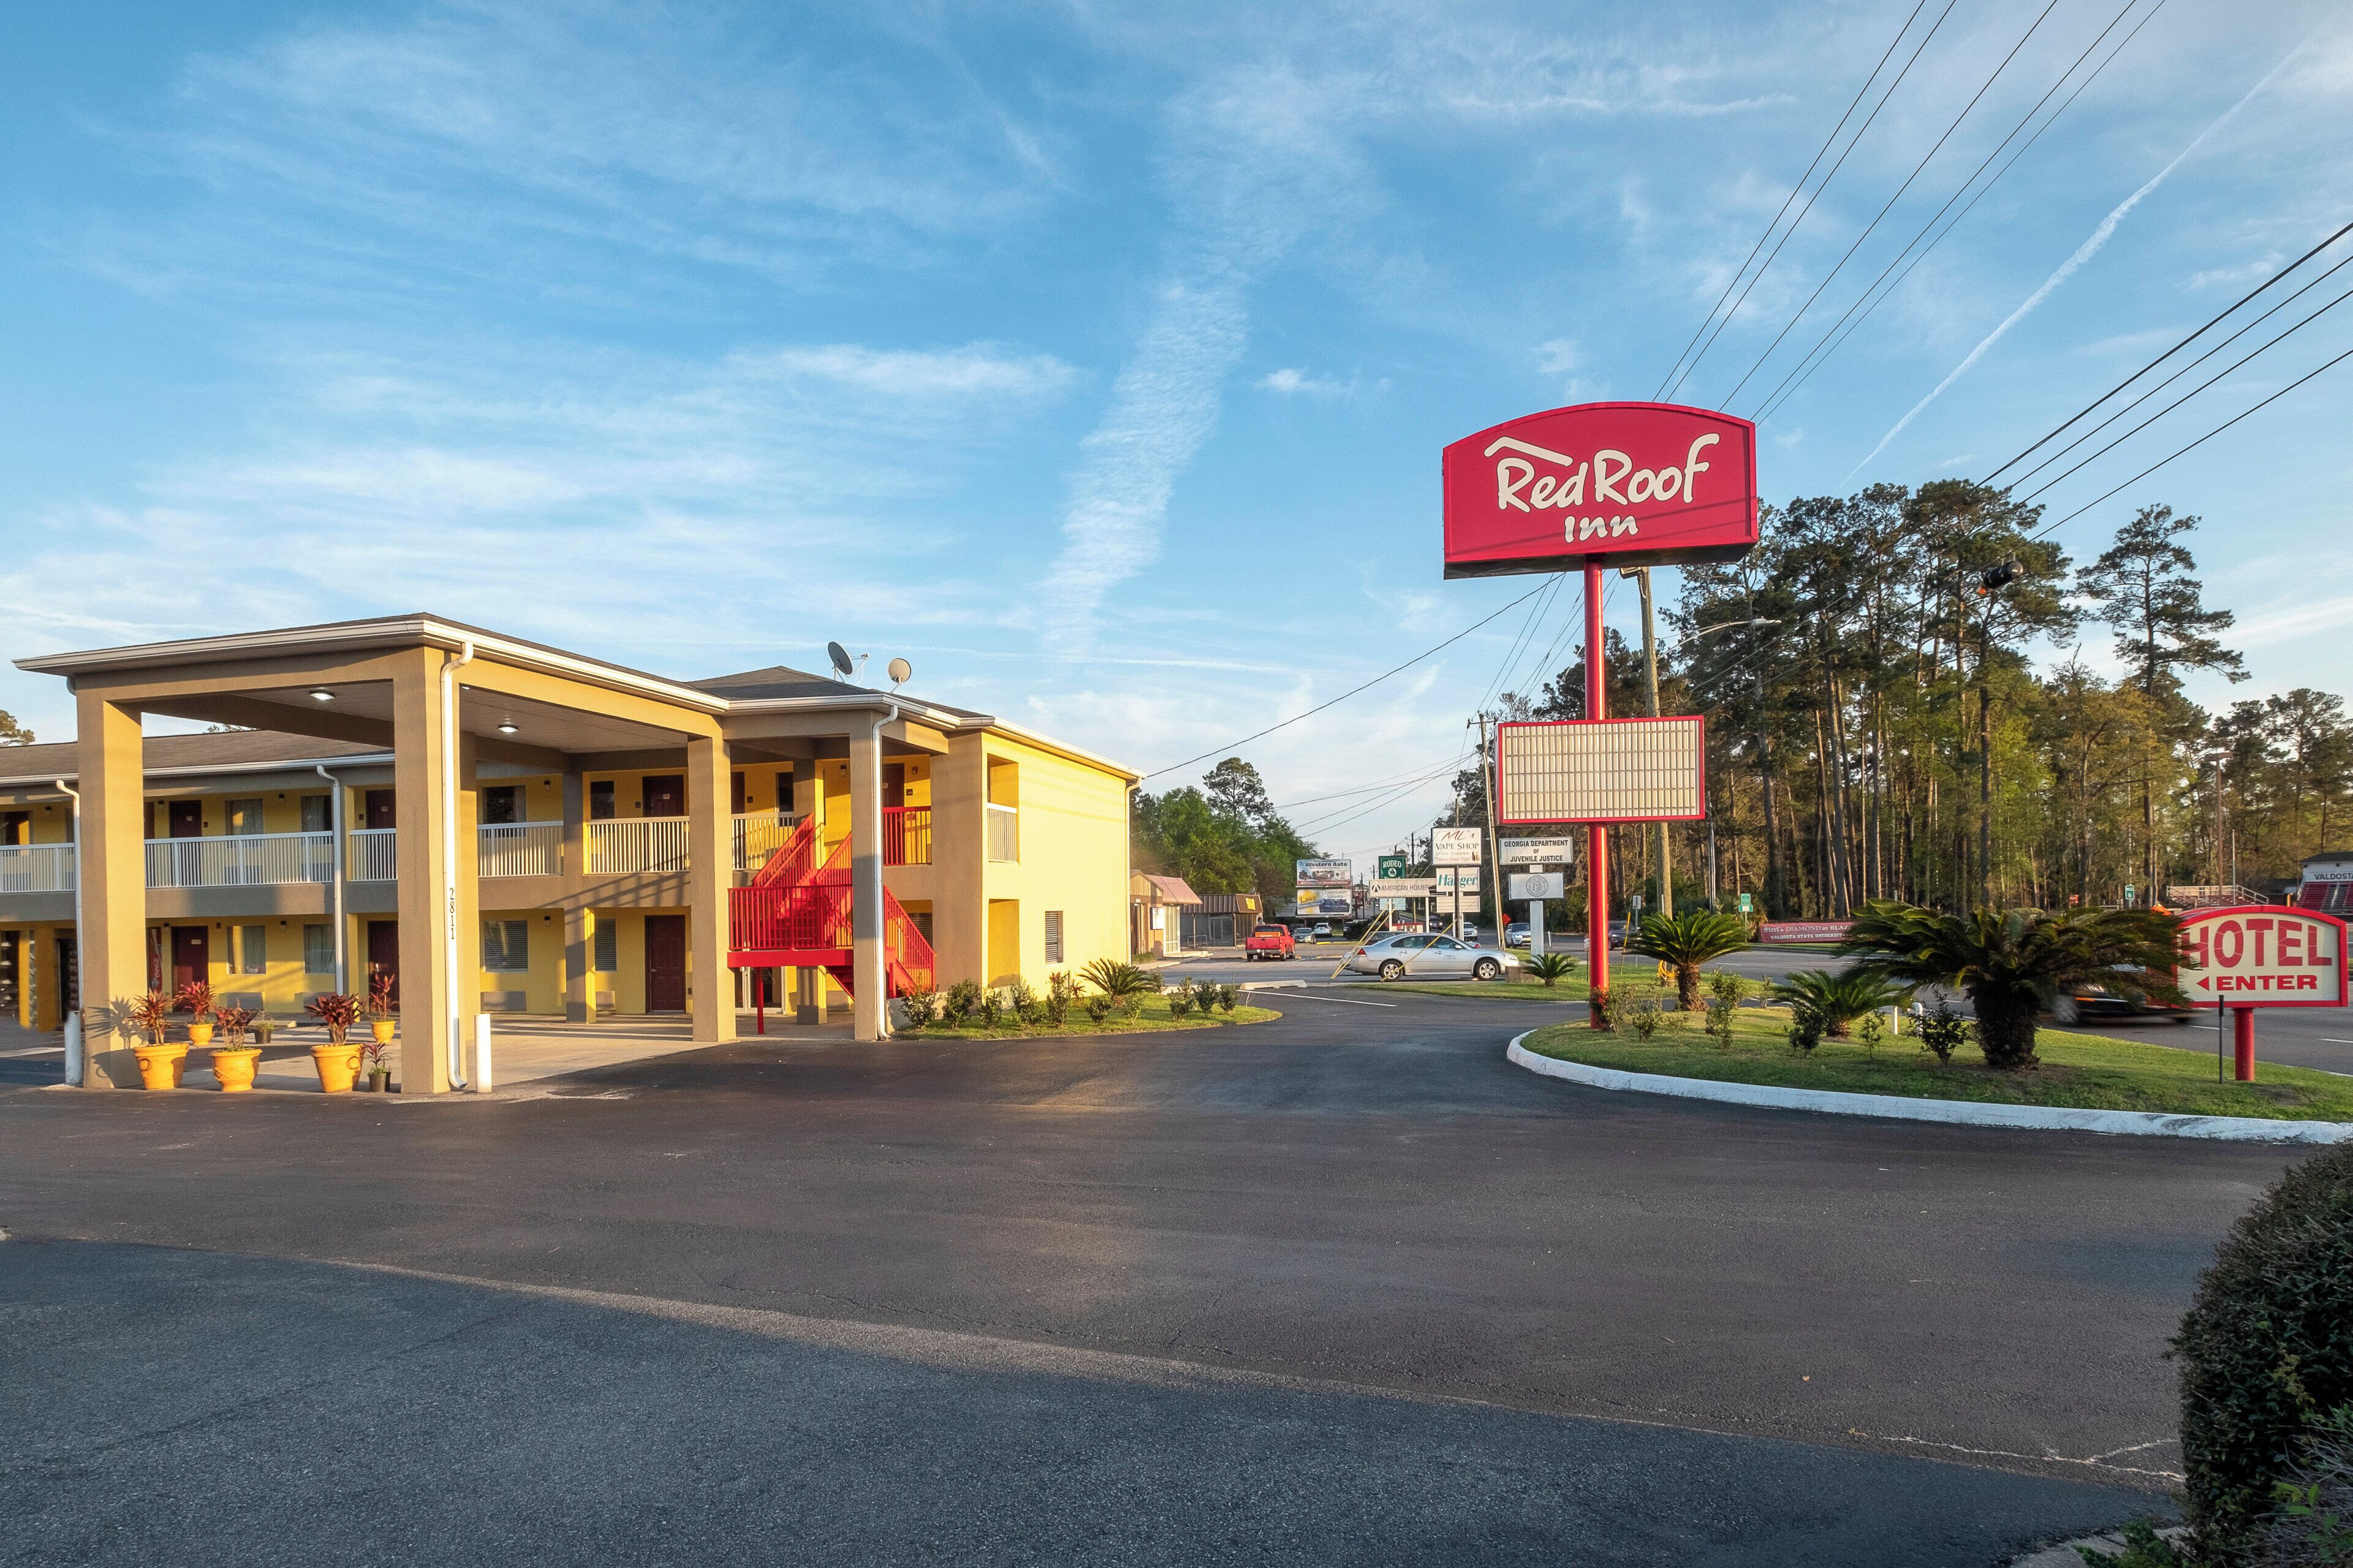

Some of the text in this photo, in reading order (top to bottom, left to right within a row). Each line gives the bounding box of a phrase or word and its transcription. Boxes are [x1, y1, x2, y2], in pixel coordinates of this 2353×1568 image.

[1382, 860, 1402, 868] RODEO
[1438, 874, 1478, 888] Hager
[2181, 918, 2332, 968] HOTEL
[2216, 975, 2317, 991] ENTER
